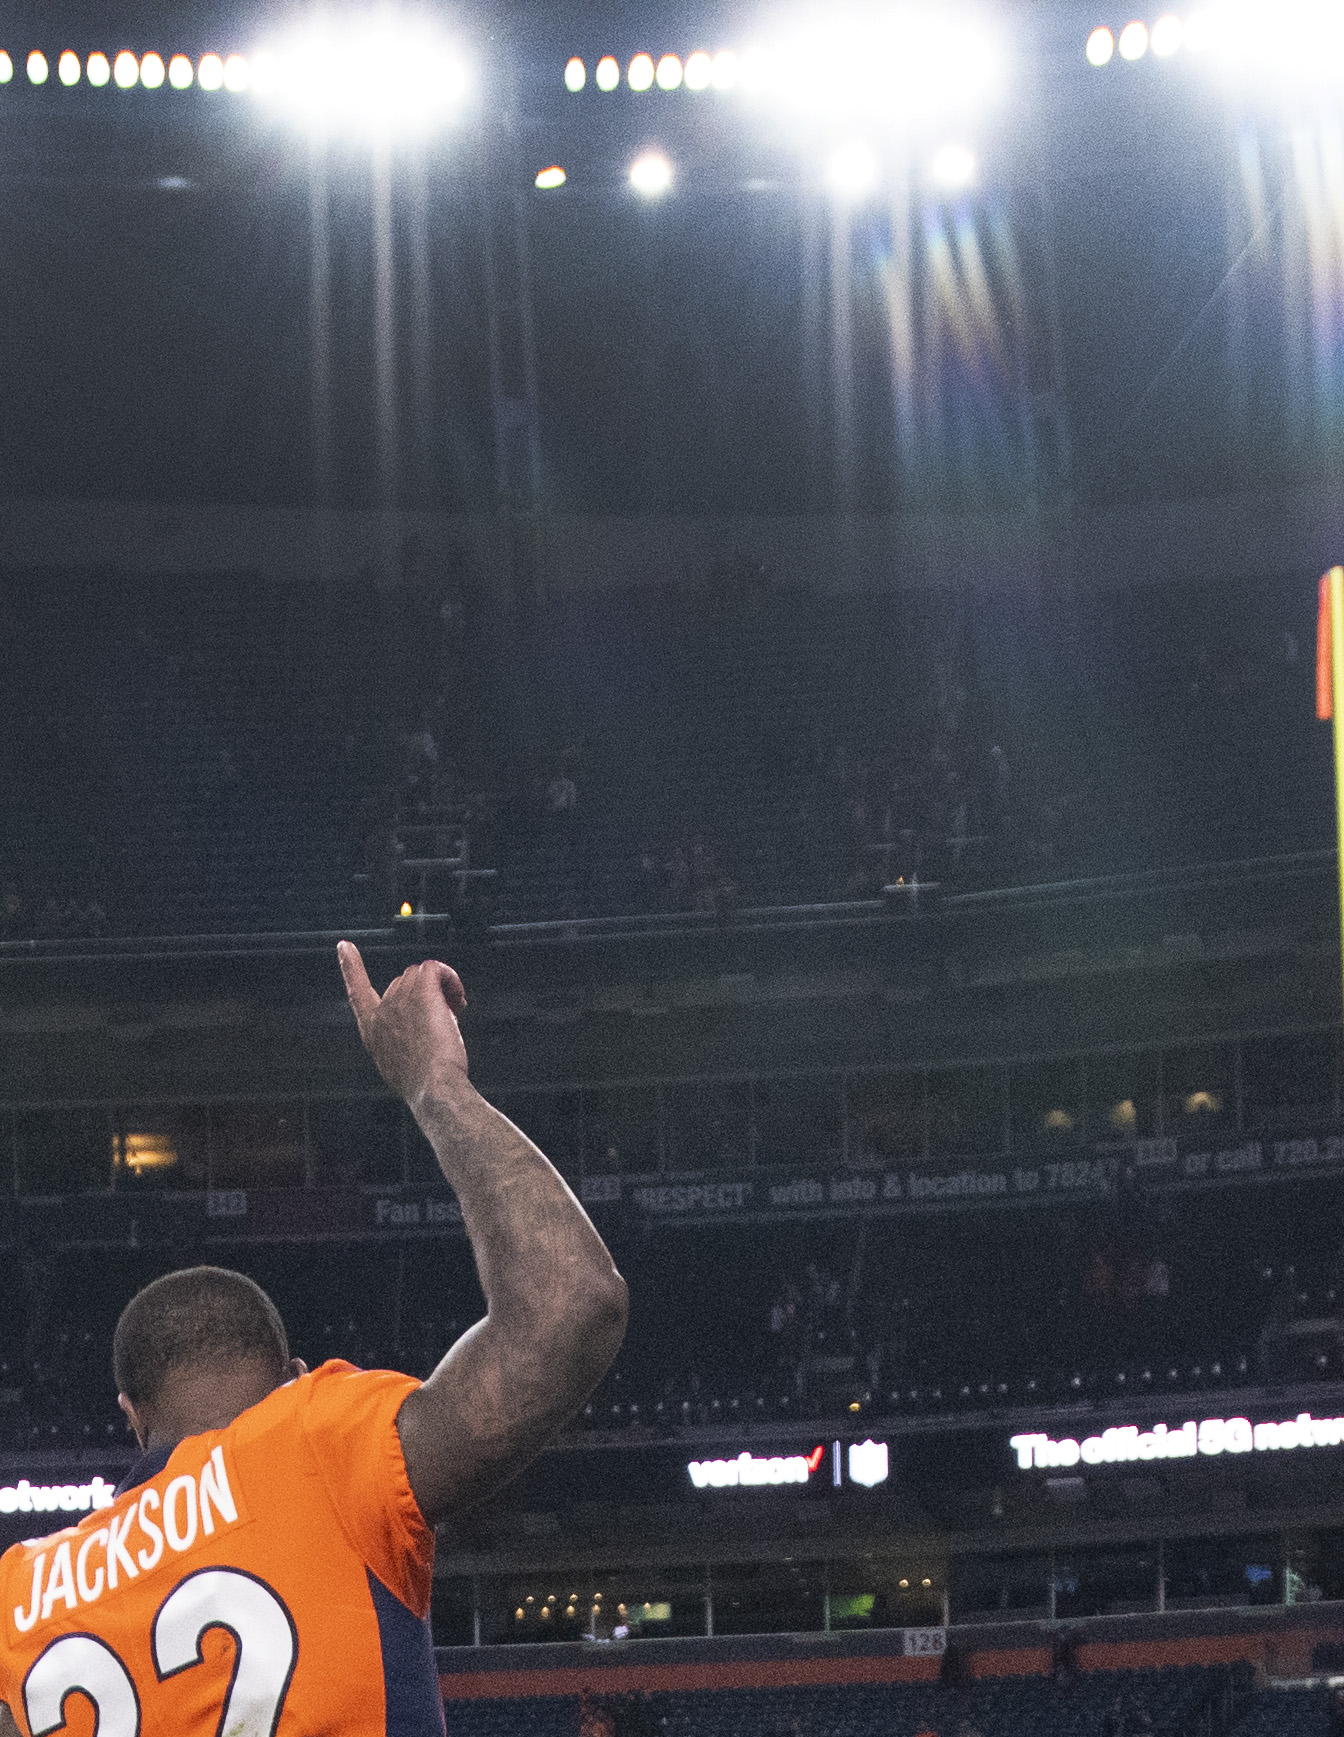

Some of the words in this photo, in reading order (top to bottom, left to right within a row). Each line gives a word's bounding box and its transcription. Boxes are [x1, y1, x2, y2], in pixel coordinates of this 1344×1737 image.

[769, 1178, 821, 1204] with
[830, 1177, 875, 1201] info
[882, 1174, 900, 1198] &
[909, 1170, 1007, 1197] location
[1014, 1168, 1039, 1191] to
[1182, 1151, 1209, 1175] or
[1213, 1142, 1261, 1170] call
[375, 1199, 419, 1224] Fan
[425, 1198, 462, 1222] iss
[1010, 1433, 1079, 1469] The
[1080, 1420, 1197, 1465] official
[1197, 1416, 1253, 1455] 5G
[688, 1451, 809, 1487] verizon
[14, 1445, 240, 1632] JACKSON
[908, 1632, 945, 1651] 128
